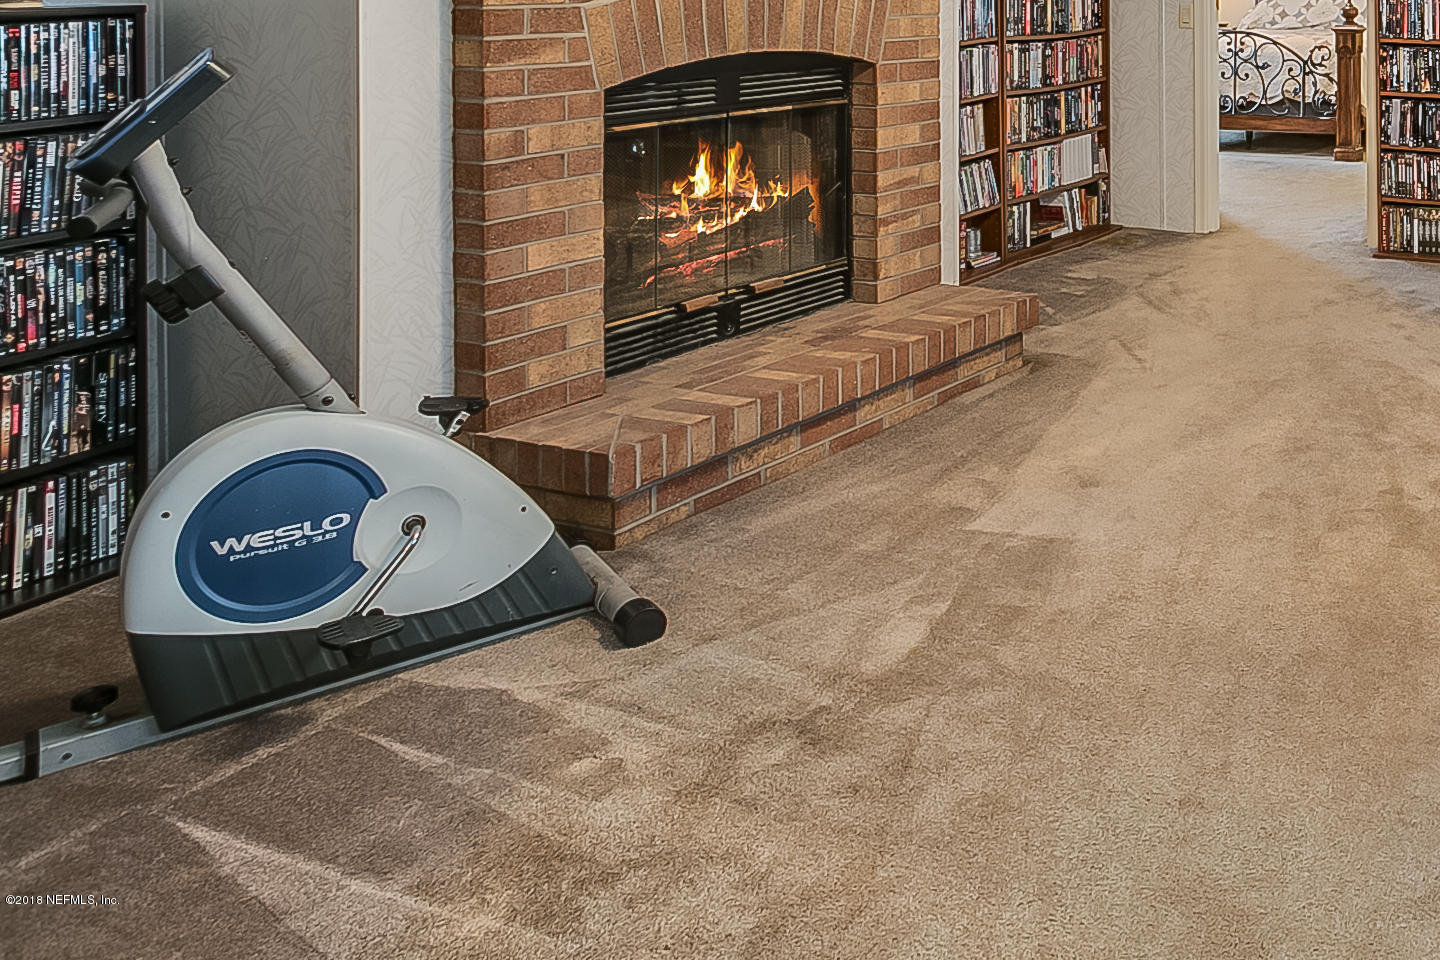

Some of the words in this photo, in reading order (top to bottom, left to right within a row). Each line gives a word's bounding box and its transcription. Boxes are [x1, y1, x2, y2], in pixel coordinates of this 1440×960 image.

[11, 170, 22, 206] WHISPER
[97, 371, 108, 424] SERENITY
[209, 512, 351, 556] WESLO
[229, 543, 289, 562] pursuit
[311, 531, 338, 544] 3.8
